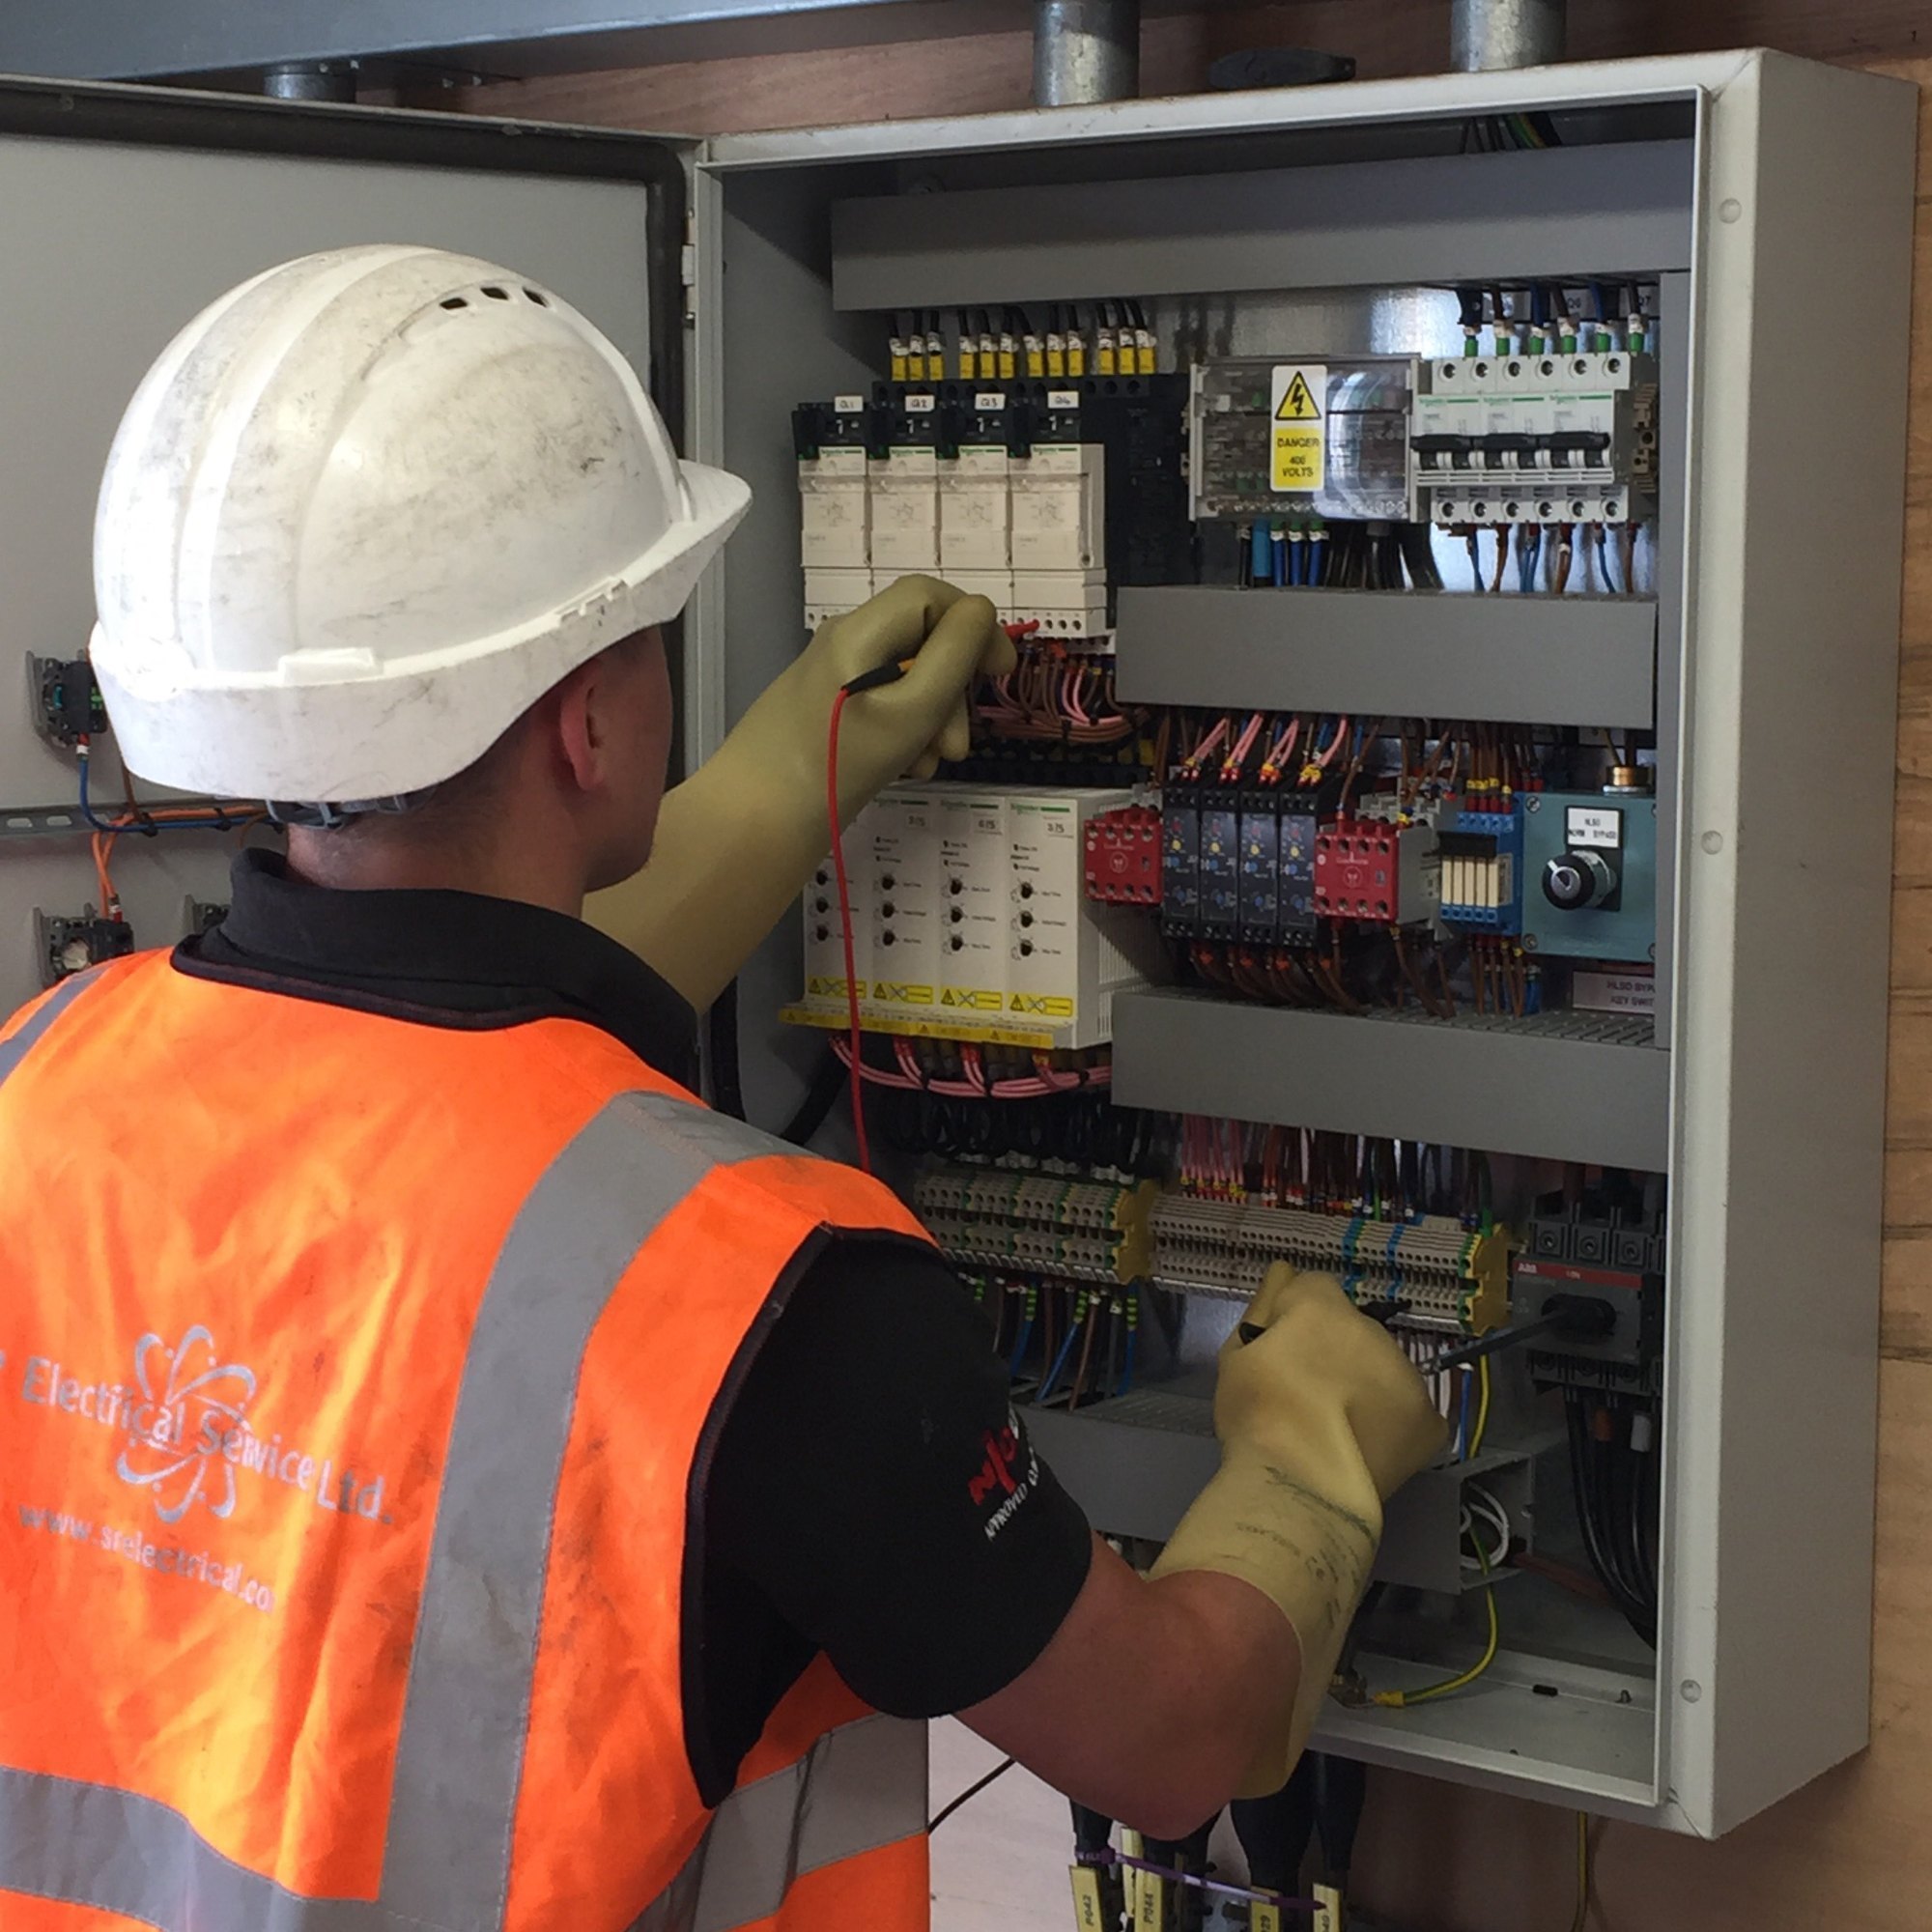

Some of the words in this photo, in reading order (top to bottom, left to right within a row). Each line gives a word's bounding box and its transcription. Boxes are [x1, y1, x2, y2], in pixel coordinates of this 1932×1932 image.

[1277, 437, 1321, 448] DANGER
[1282, 467, 1314, 477] VOLTS
[22, 1355, 185, 1446] Electrical
[196, 1408, 315, 1492] Service
[317, 1459, 394, 1525] Ltd.
